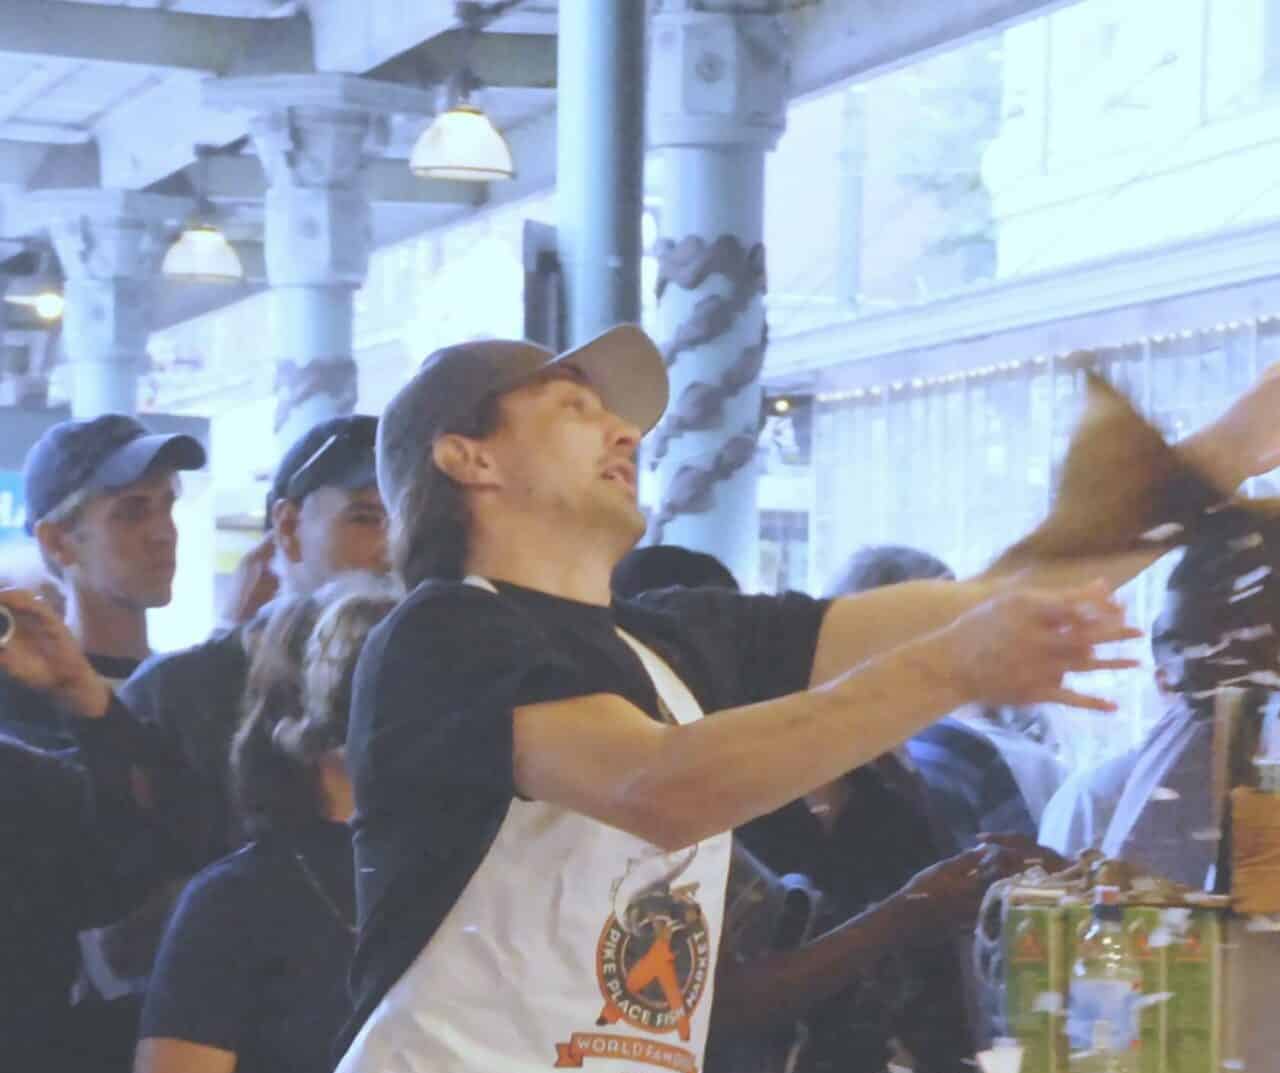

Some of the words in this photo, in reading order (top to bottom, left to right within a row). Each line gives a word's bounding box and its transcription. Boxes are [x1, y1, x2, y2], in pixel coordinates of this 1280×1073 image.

[603, 927, 622, 974] PIKE
[606, 979, 651, 1026] PLACE
[576, 1037, 642, 1058] WORLD
